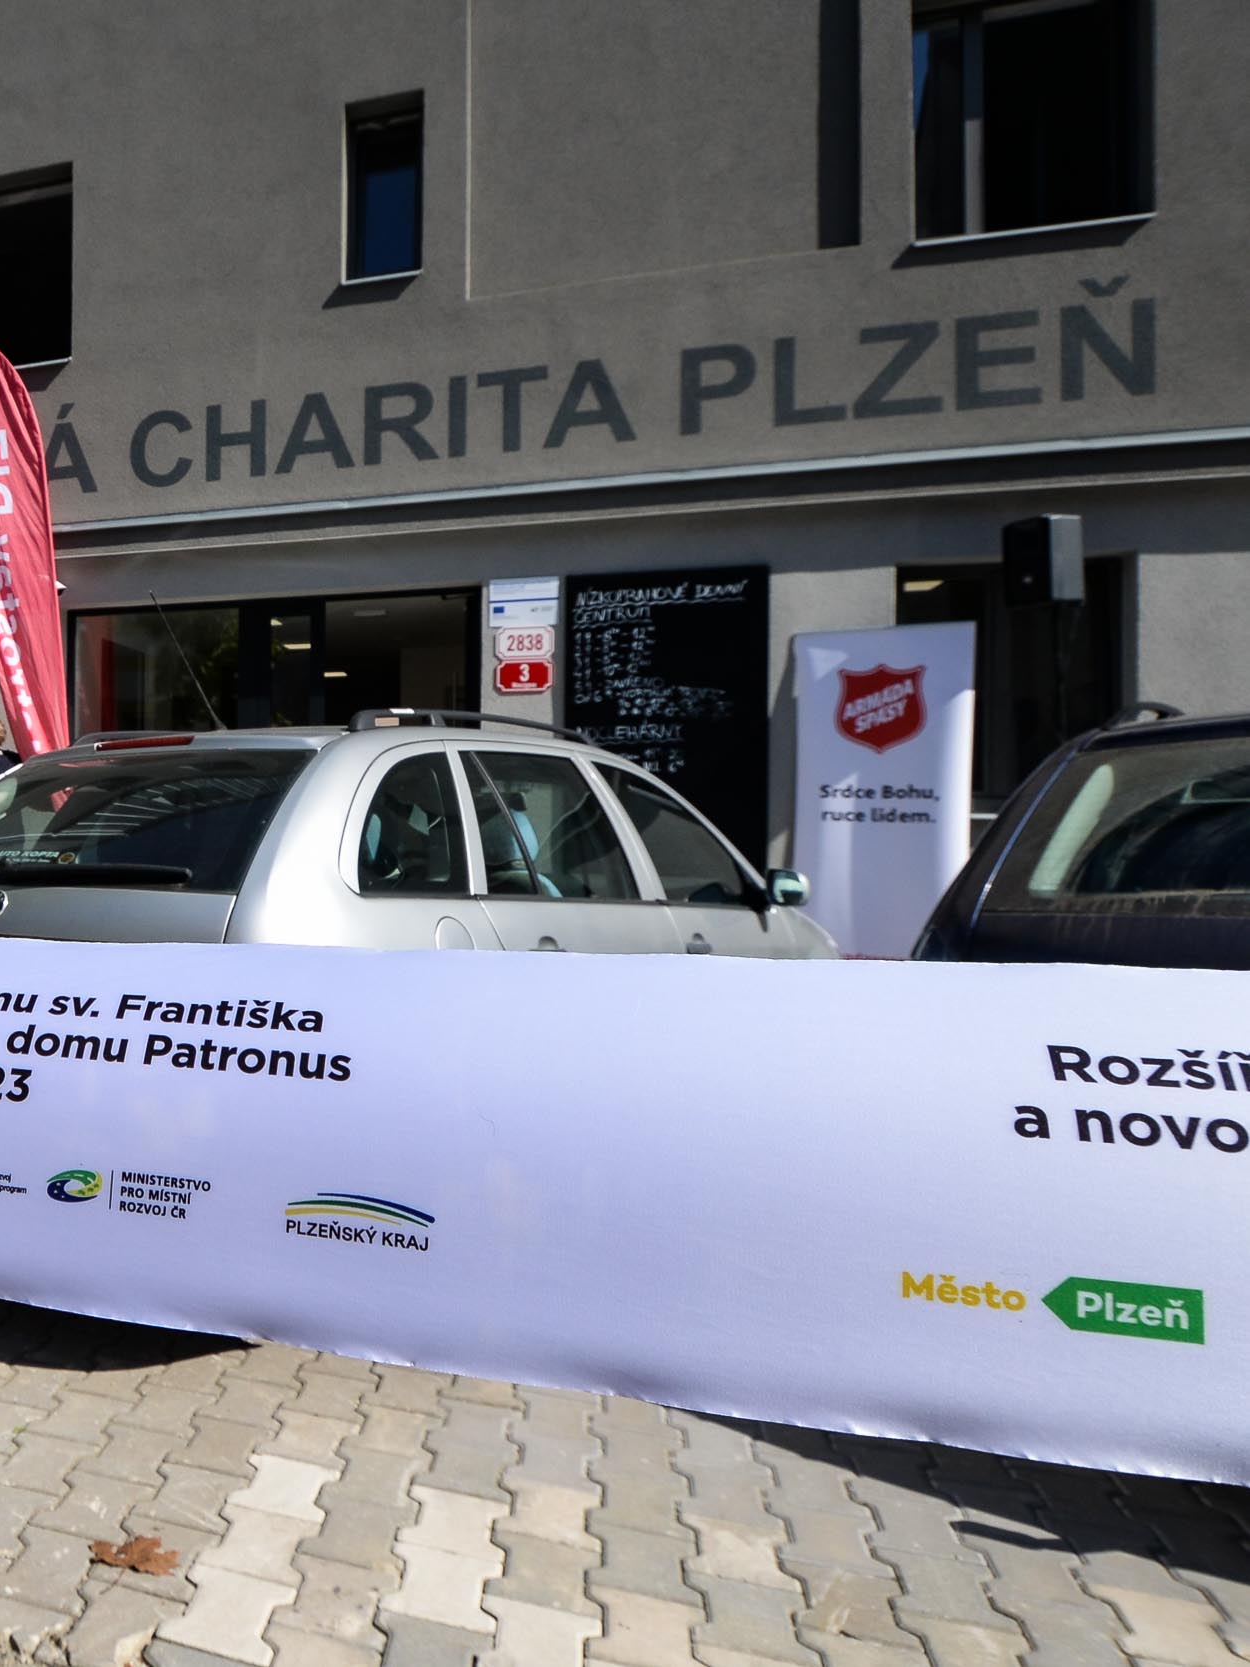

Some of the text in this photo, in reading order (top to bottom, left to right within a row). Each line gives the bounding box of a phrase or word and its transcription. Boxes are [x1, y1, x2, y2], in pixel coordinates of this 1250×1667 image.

[129, 358, 637, 489] CHARITA
[679, 273, 1155, 437] PLZEŇ
[507, 633, 543, 652] 2838
[518, 663, 530, 682] 3
[819, 784, 940, 801] Srdce Bohu,
[821, 808, 937, 824] ruce lidem.
[48, 995, 100, 1018] sv.
[115, 994, 324, 1033] Františka
[6, 1024, 129, 1063] domu
[143, 1034, 352, 1083] Patronus
[1013, 1105, 1249, 1153] a novo
[0, 1184, 27, 1195] program
[121, 1171, 211, 1192] MINISTERSTVO
[120, 1185, 192, 1205] PRO MÍSTNÍ
[119, 1200, 187, 1220] ROZVOJ ČR
[285, 1218, 430, 1253] PLZEŇSKÝ KRAJ
[900, 1270, 1190, 1331] Město Plzeň
